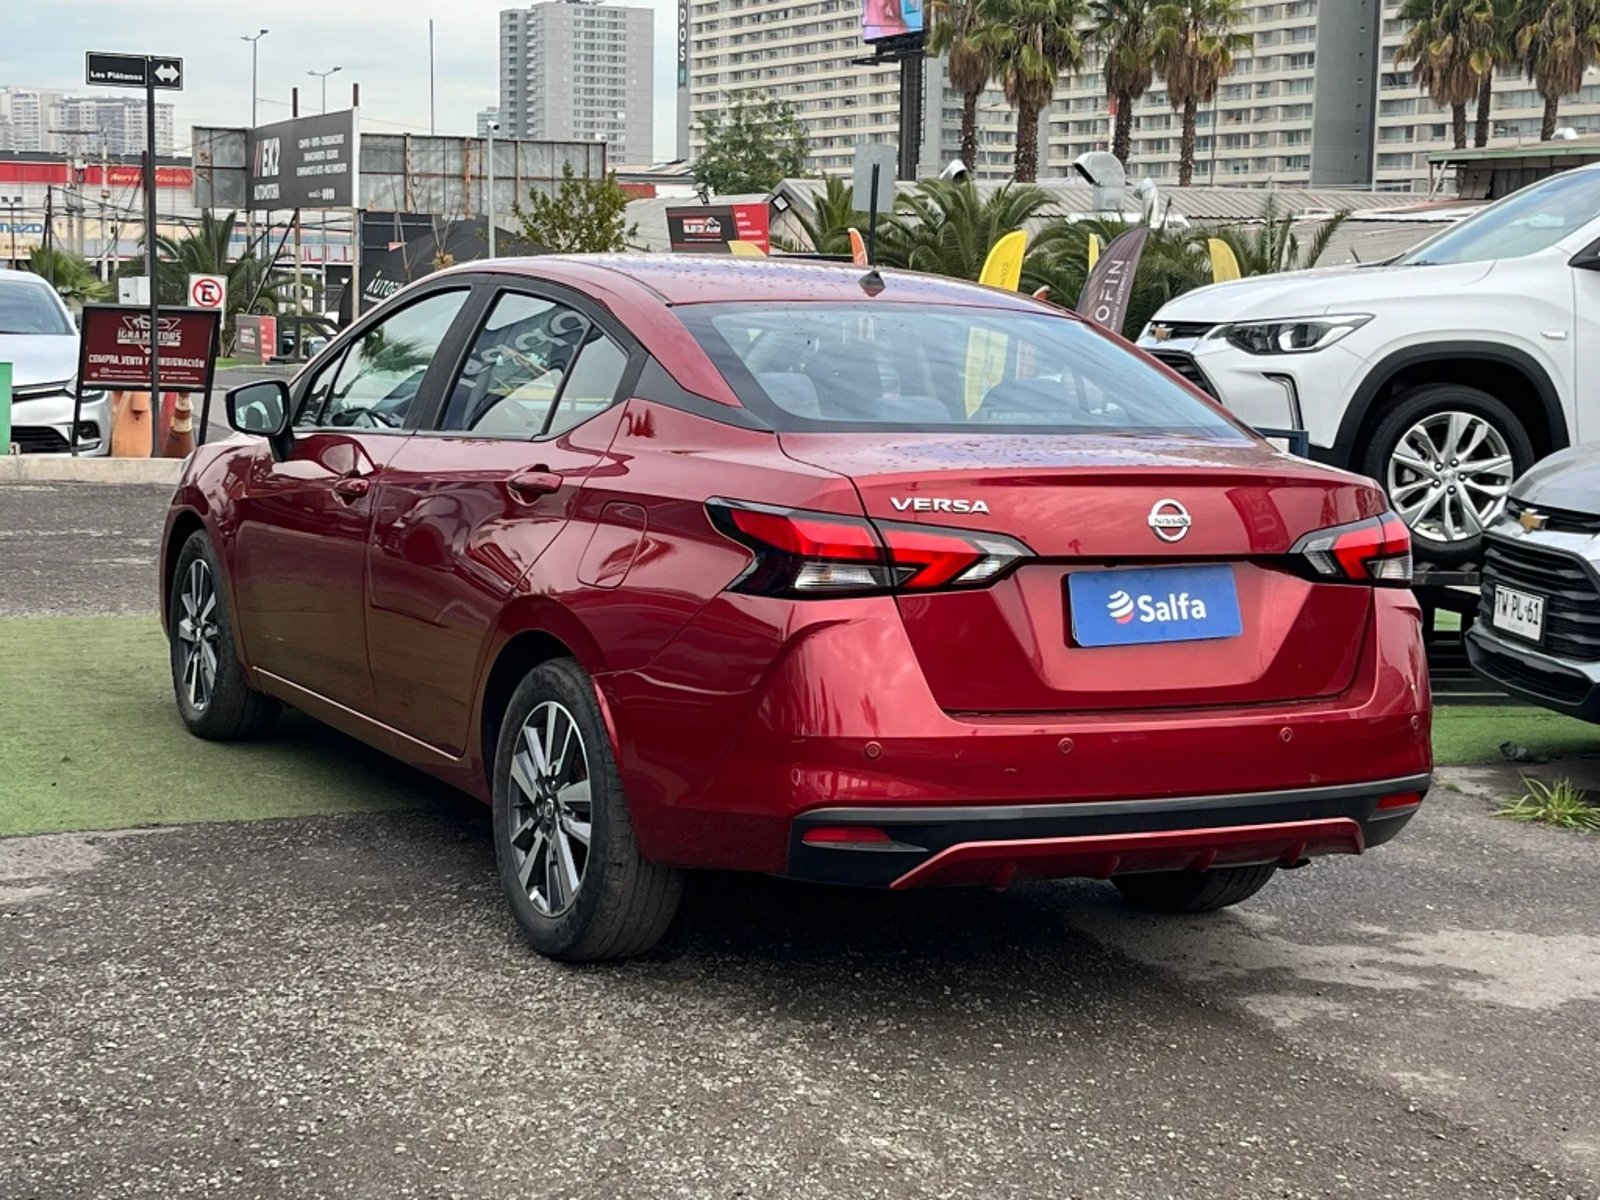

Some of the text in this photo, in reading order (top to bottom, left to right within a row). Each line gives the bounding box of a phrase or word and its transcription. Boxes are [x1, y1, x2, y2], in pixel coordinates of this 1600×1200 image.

[90, 70, 106, 79] Los
[142, 331, 181, 341] MTORS
[889, 497, 991, 515] VERSA
[1137, 592, 1207, 622] Salfa
